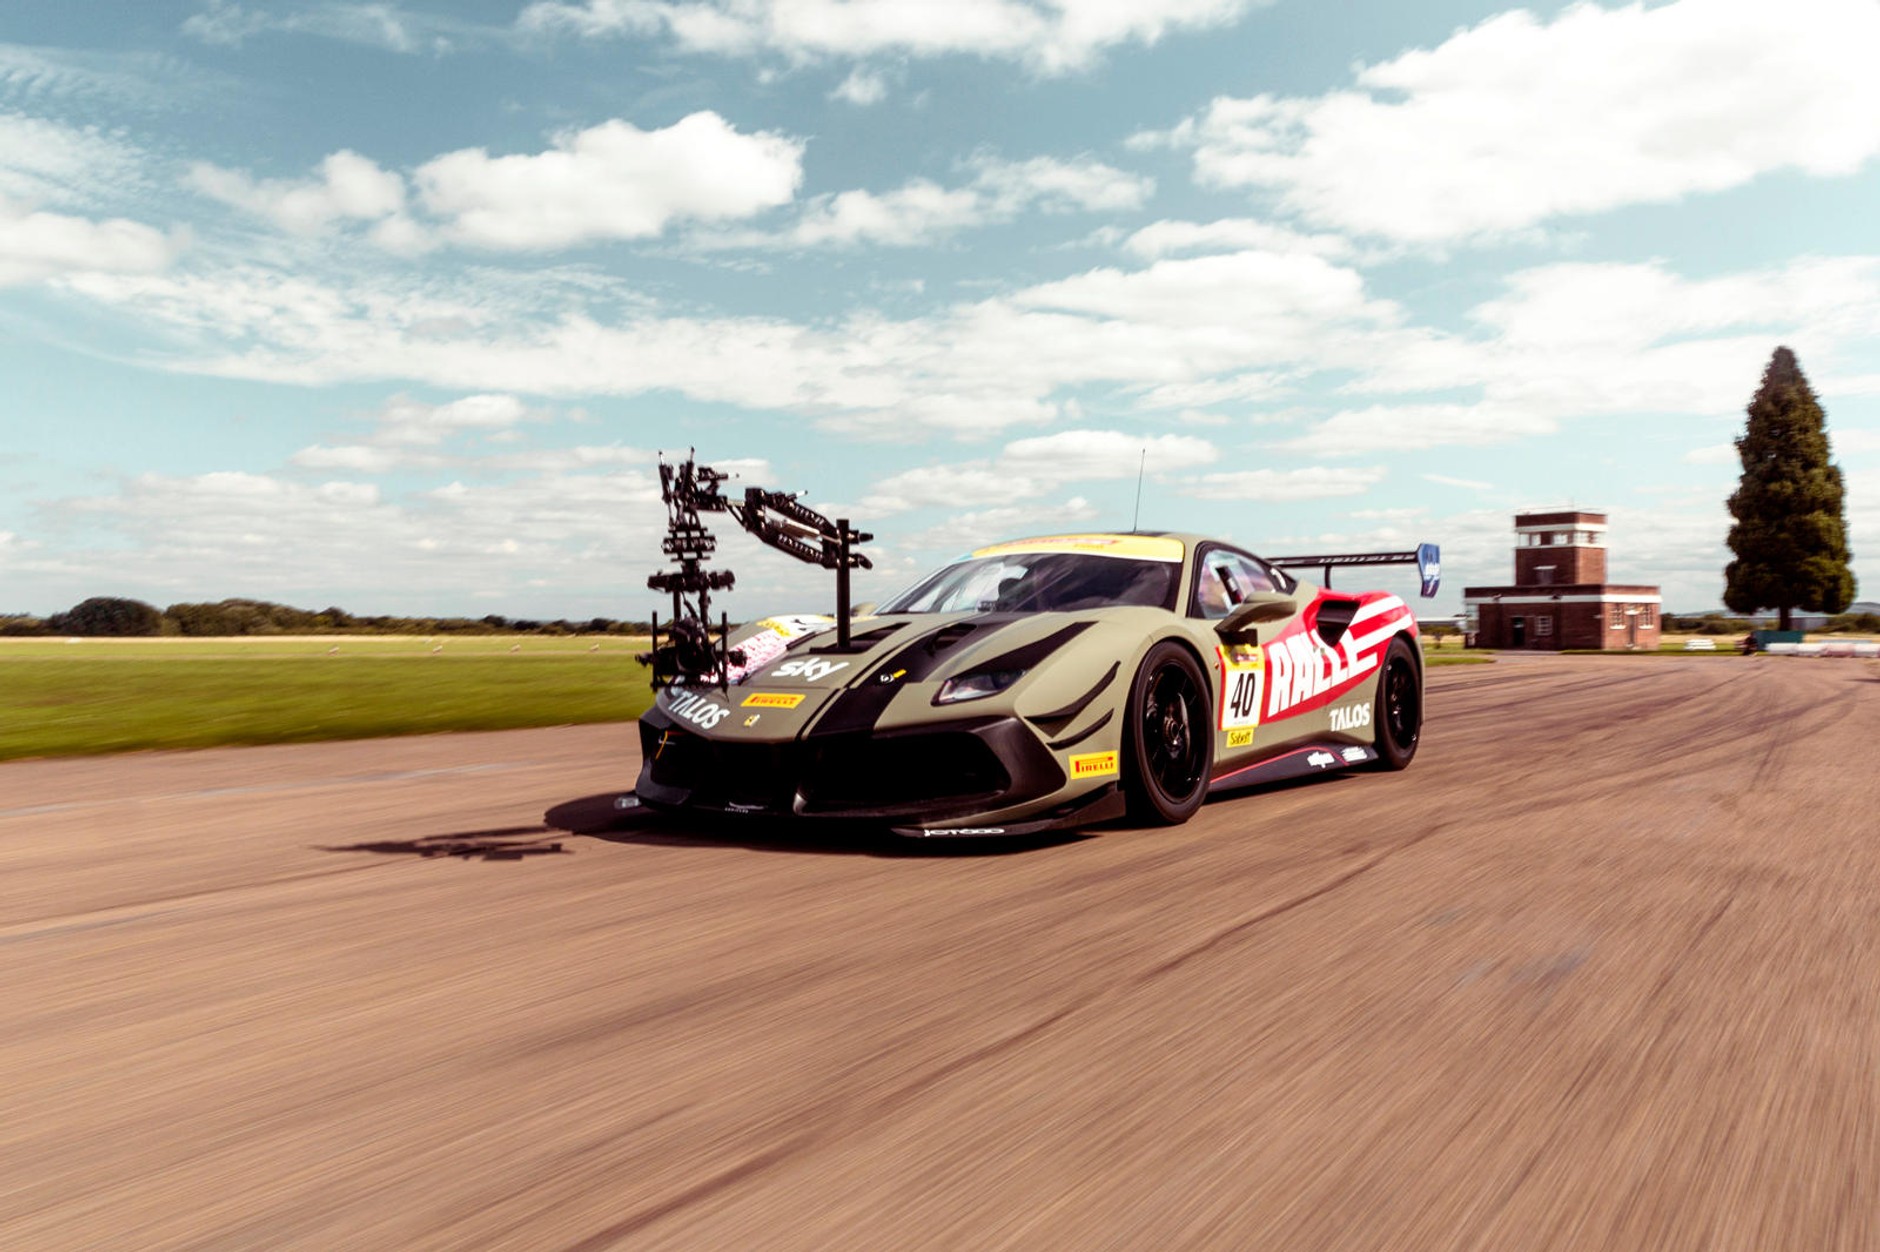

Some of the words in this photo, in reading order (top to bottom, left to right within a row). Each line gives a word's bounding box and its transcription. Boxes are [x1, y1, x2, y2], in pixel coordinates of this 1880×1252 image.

[771, 657, 850, 682] sky
[667, 690, 731, 730] TALOS
[1230, 672, 1256, 718] 40
[1329, 702, 1371, 732] TALOS
[1074, 756, 1114, 773] PIRELLI
